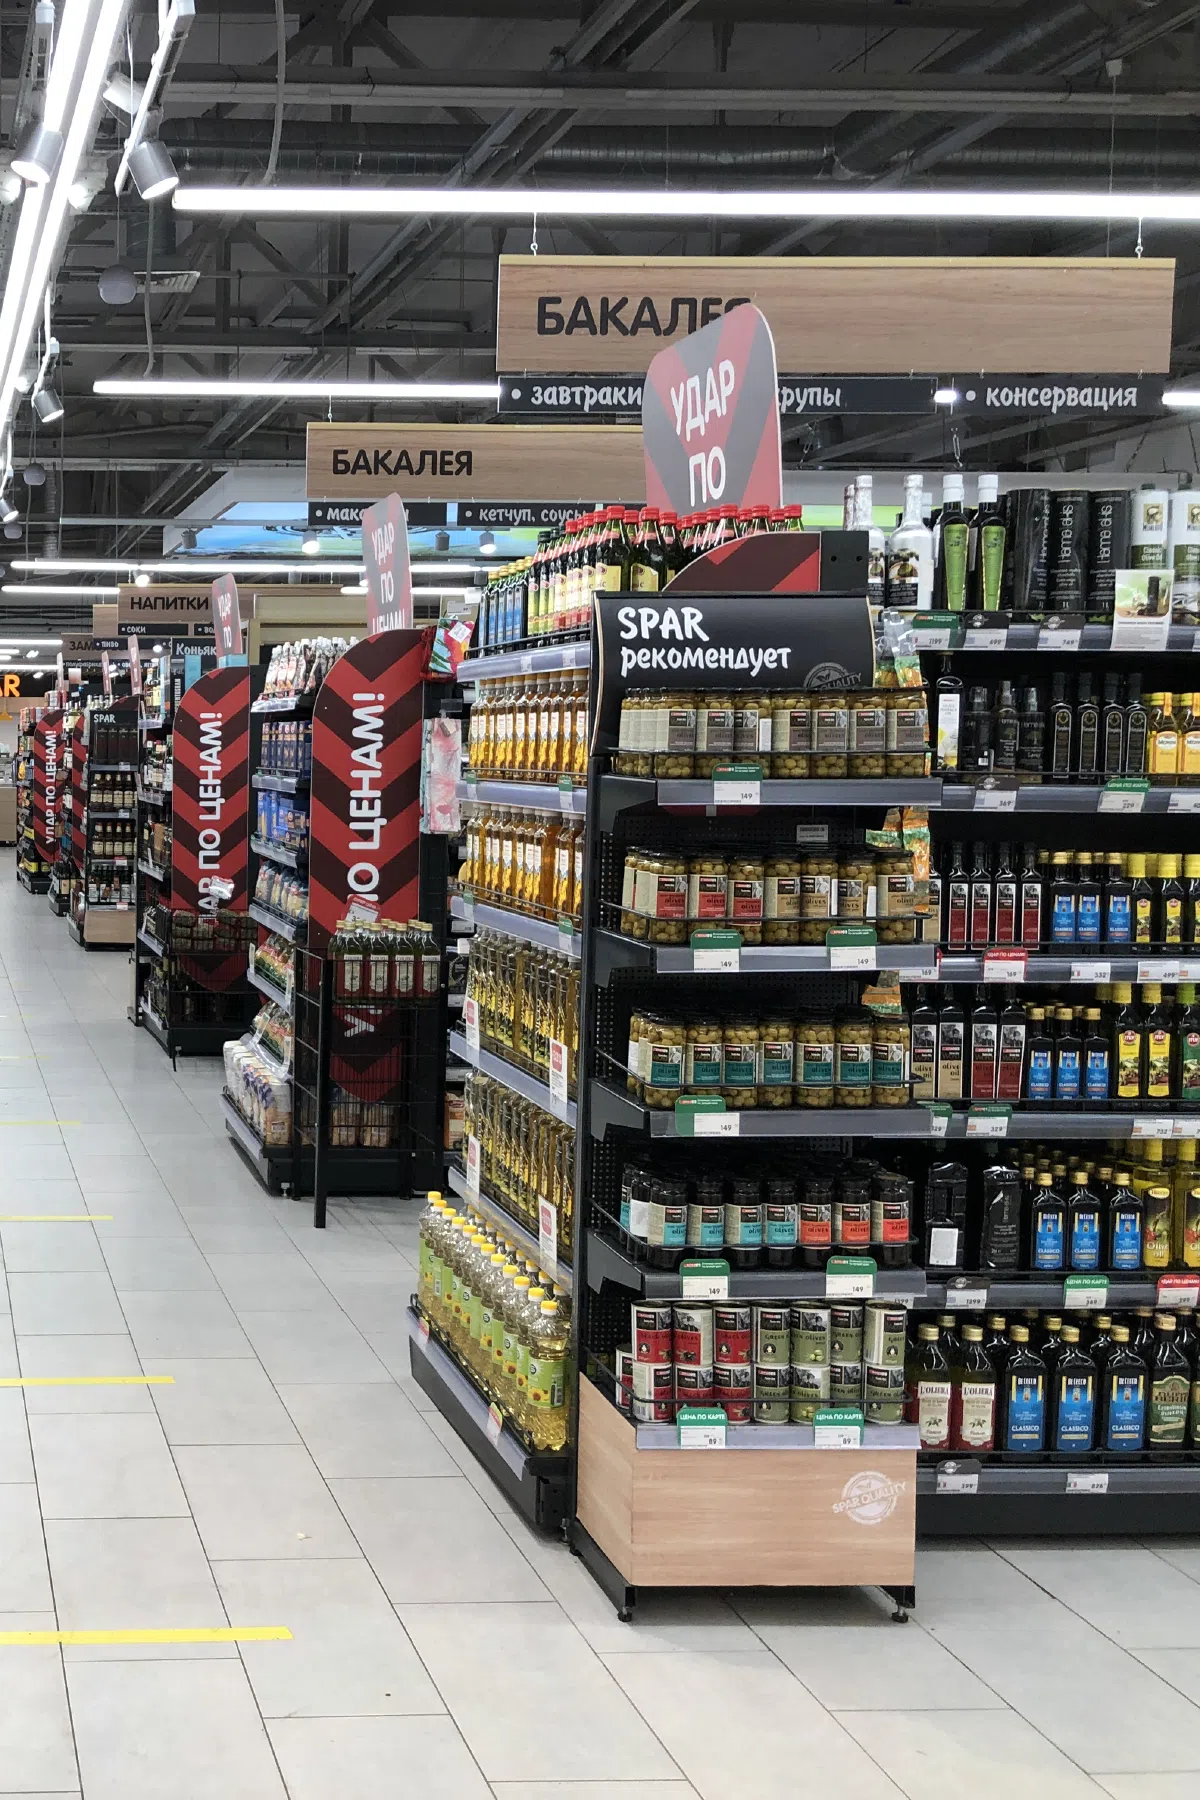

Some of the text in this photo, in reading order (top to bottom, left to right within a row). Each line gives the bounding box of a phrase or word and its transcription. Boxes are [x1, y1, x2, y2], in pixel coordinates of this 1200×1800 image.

[536, 296, 752, 337] БАКАЛЕ
[531, 384, 642, 412] завтраки
[670, 359, 735, 442] УДАР
[986, 383, 1138, 411] консервация
[332, 449, 473, 476] БАКАЛЕЯ
[689, 446, 726, 507] ПО
[480, 508, 536, 525] кетчуп,
[372, 521, 395, 566] УДАР
[380, 572, 394, 604] ПО
[130, 596, 209, 610] НАПИТКИ
[617, 607, 710, 642] SPAR
[176, 643, 217, 655] Коньяк
[620, 646, 792, 678] рекомендует
[94, 714, 116, 723] SPAR
[349, 692, 387, 850] ЦЕНАМ!
[198, 711, 226, 870] ПО ЦЕНАМ!
[680, 1413, 696, 1422] ЦЕНА
[707, 1413, 726, 1421] КАРТЕ
[816, 1414, 832, 1422] ЦЕНА
[843, 1413, 862, 1421] КАРТЕ
[1011, 1424, 1040, 1432] CLASSICO
[842, 1437, 852, 1445] 89
[832, 1482, 907, 1515] SPAR QUALITY
